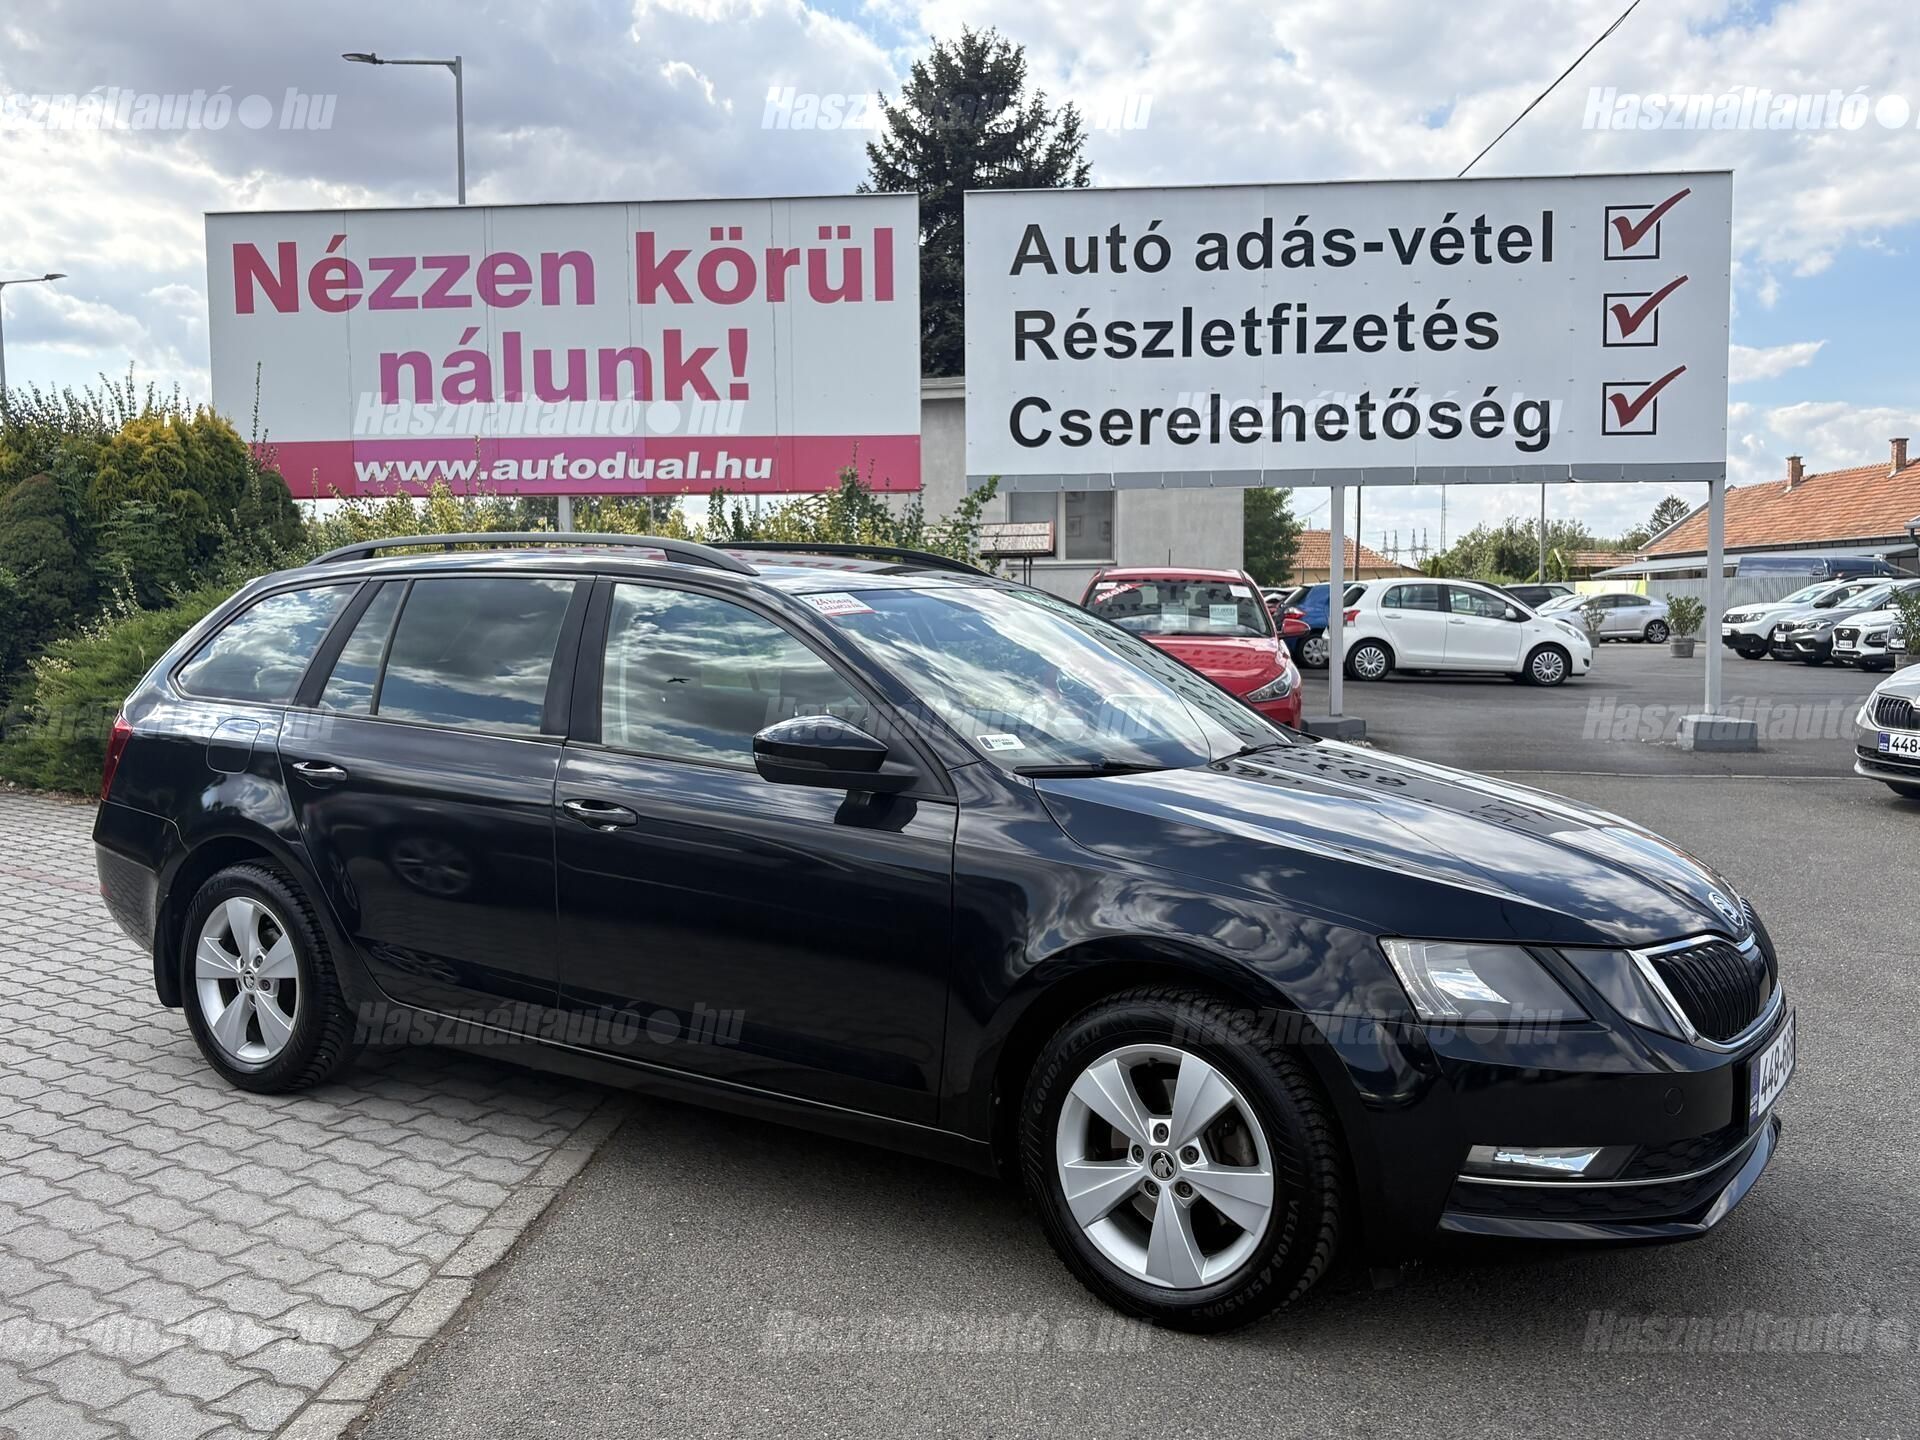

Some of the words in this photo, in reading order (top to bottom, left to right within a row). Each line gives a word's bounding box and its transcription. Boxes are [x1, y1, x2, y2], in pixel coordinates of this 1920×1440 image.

[231, 234, 595, 315] Nézzen
[635, 225, 895, 305] körül
[1009, 220, 1172, 276] Autó
[1194, 210, 1554, 272] adás-vétel
[1014, 297, 1501, 362] Részletfizetés
[379, 326, 750, 406] nálunk!
[1008, 385, 1552, 453] Cserelehetőség
[354, 451, 773, 483] www.autodual.hu
[1891, 736, 1920, 753] 448
